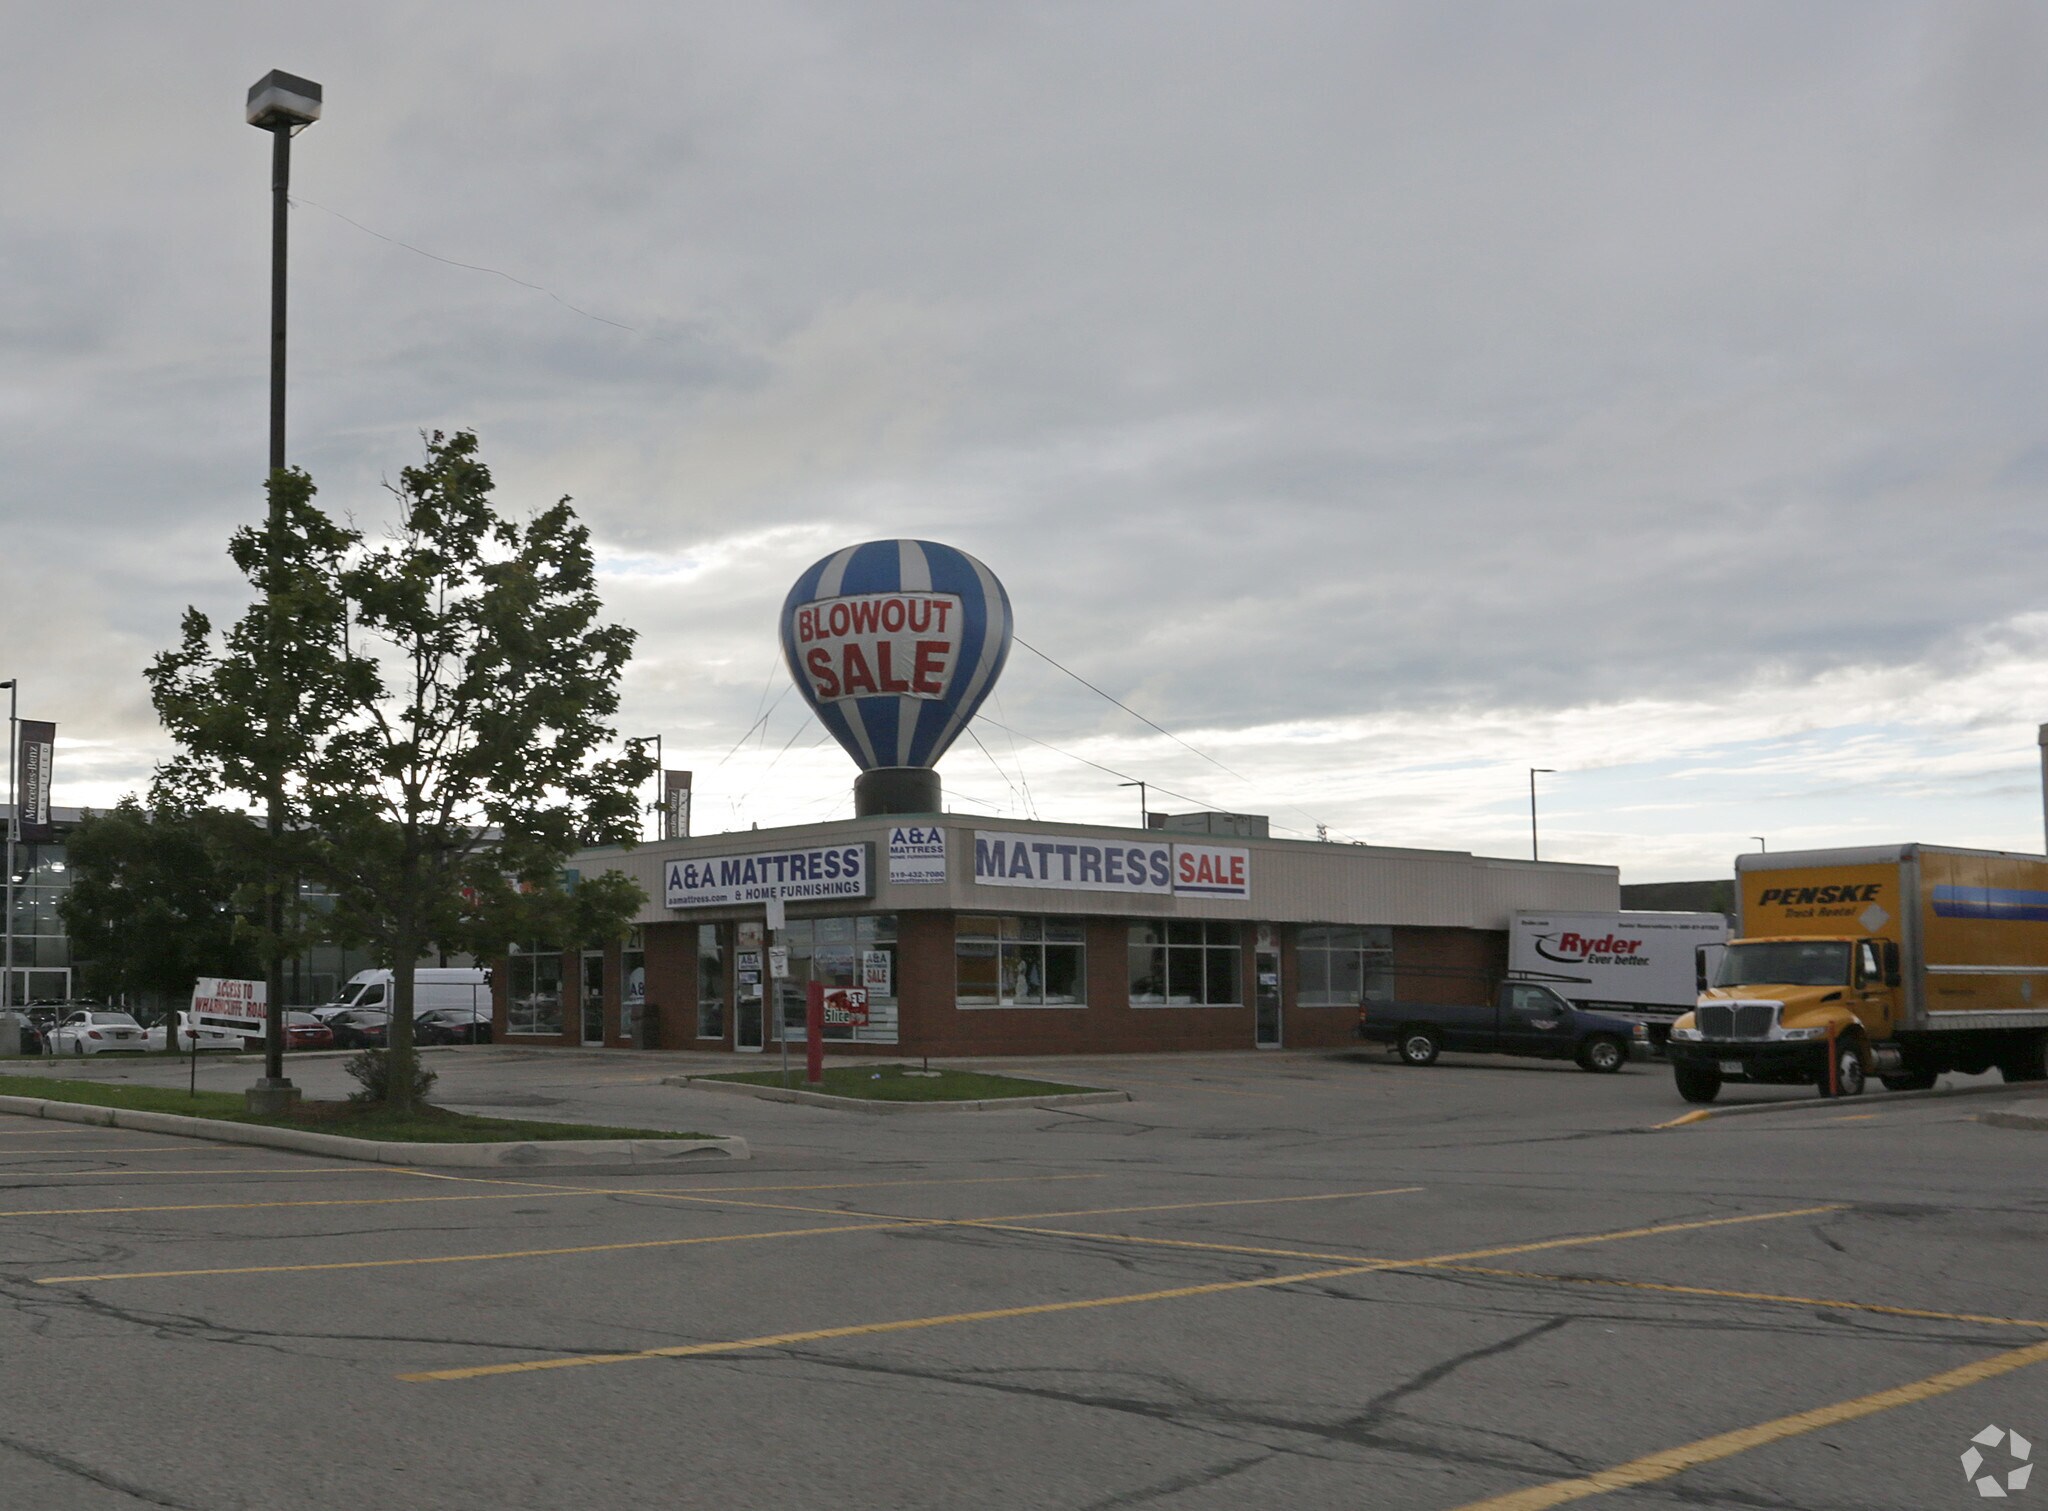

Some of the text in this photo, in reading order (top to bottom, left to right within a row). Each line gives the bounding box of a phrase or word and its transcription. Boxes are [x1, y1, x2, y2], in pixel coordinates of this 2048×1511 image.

[800, 599, 952, 643] BLOWOUT
[807, 641, 950, 697] SALE
[25, 746, 39, 820] Mercedes-Benz
[38, 747, 49, 820] CERTIFIED
[891, 826, 943, 844] A&A
[669, 848, 860, 890] A&A MATTRESS
[976, 839, 1169, 886] MATTRESS
[1179, 853, 1245, 885] SALE
[669, 881, 860, 905] aamattress.com & HOME FURNISHINGS
[1759, 884, 1882, 906] PENSKE
[1559, 933, 1642, 957] Ryder
[1588, 954, 1650, 966] Ever better.
[867, 969, 886, 984] SALE
[216, 982, 253, 999] ACCESS TO
[195, 997, 268, 1018] WHARNCLIFFE ROAD
[825, 1009, 849, 1021] Slice
